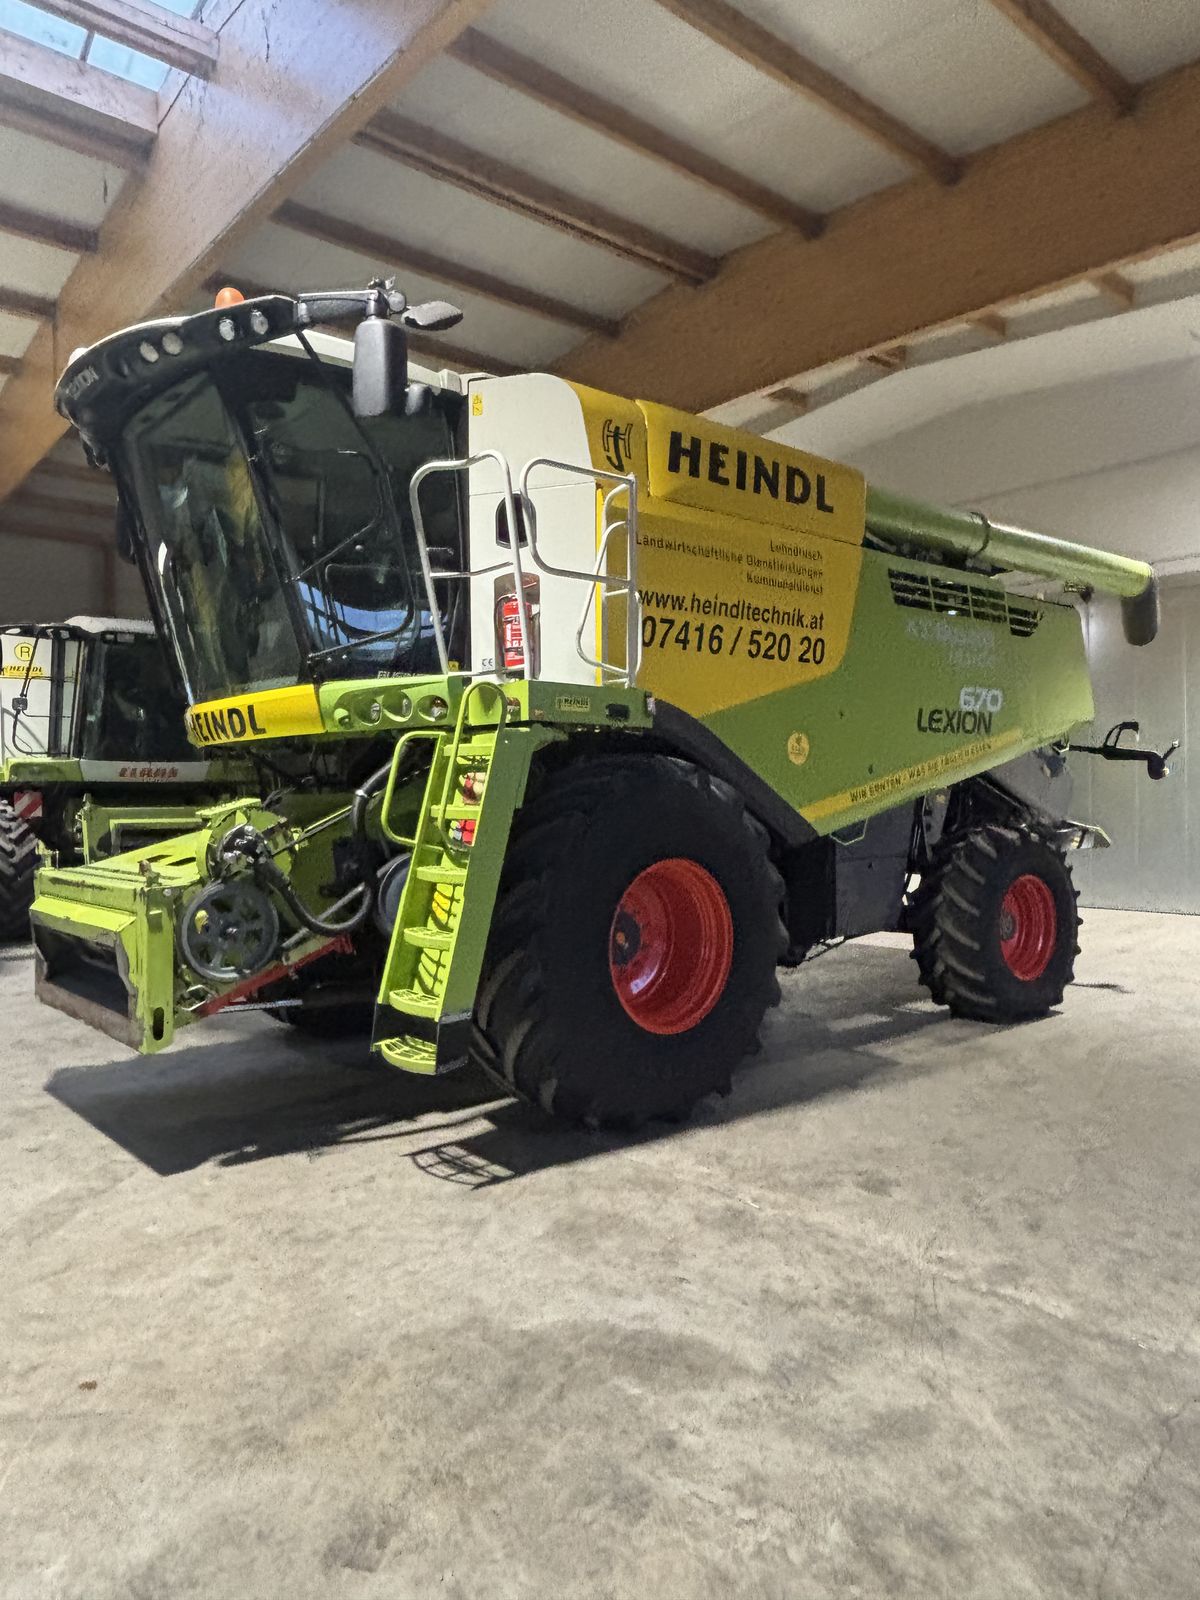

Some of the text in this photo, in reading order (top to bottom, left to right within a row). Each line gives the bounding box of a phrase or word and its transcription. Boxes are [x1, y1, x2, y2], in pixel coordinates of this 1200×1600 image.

[667, 430, 834, 514] HEINDL
[638, 589, 824, 631] www.heindltechnik.at
[20, 646, 31, 658] R
[641, 615, 825, 665] 07416 / 520 20
[960, 686, 1003, 712] 670
[917, 708, 993, 735] LEXION
